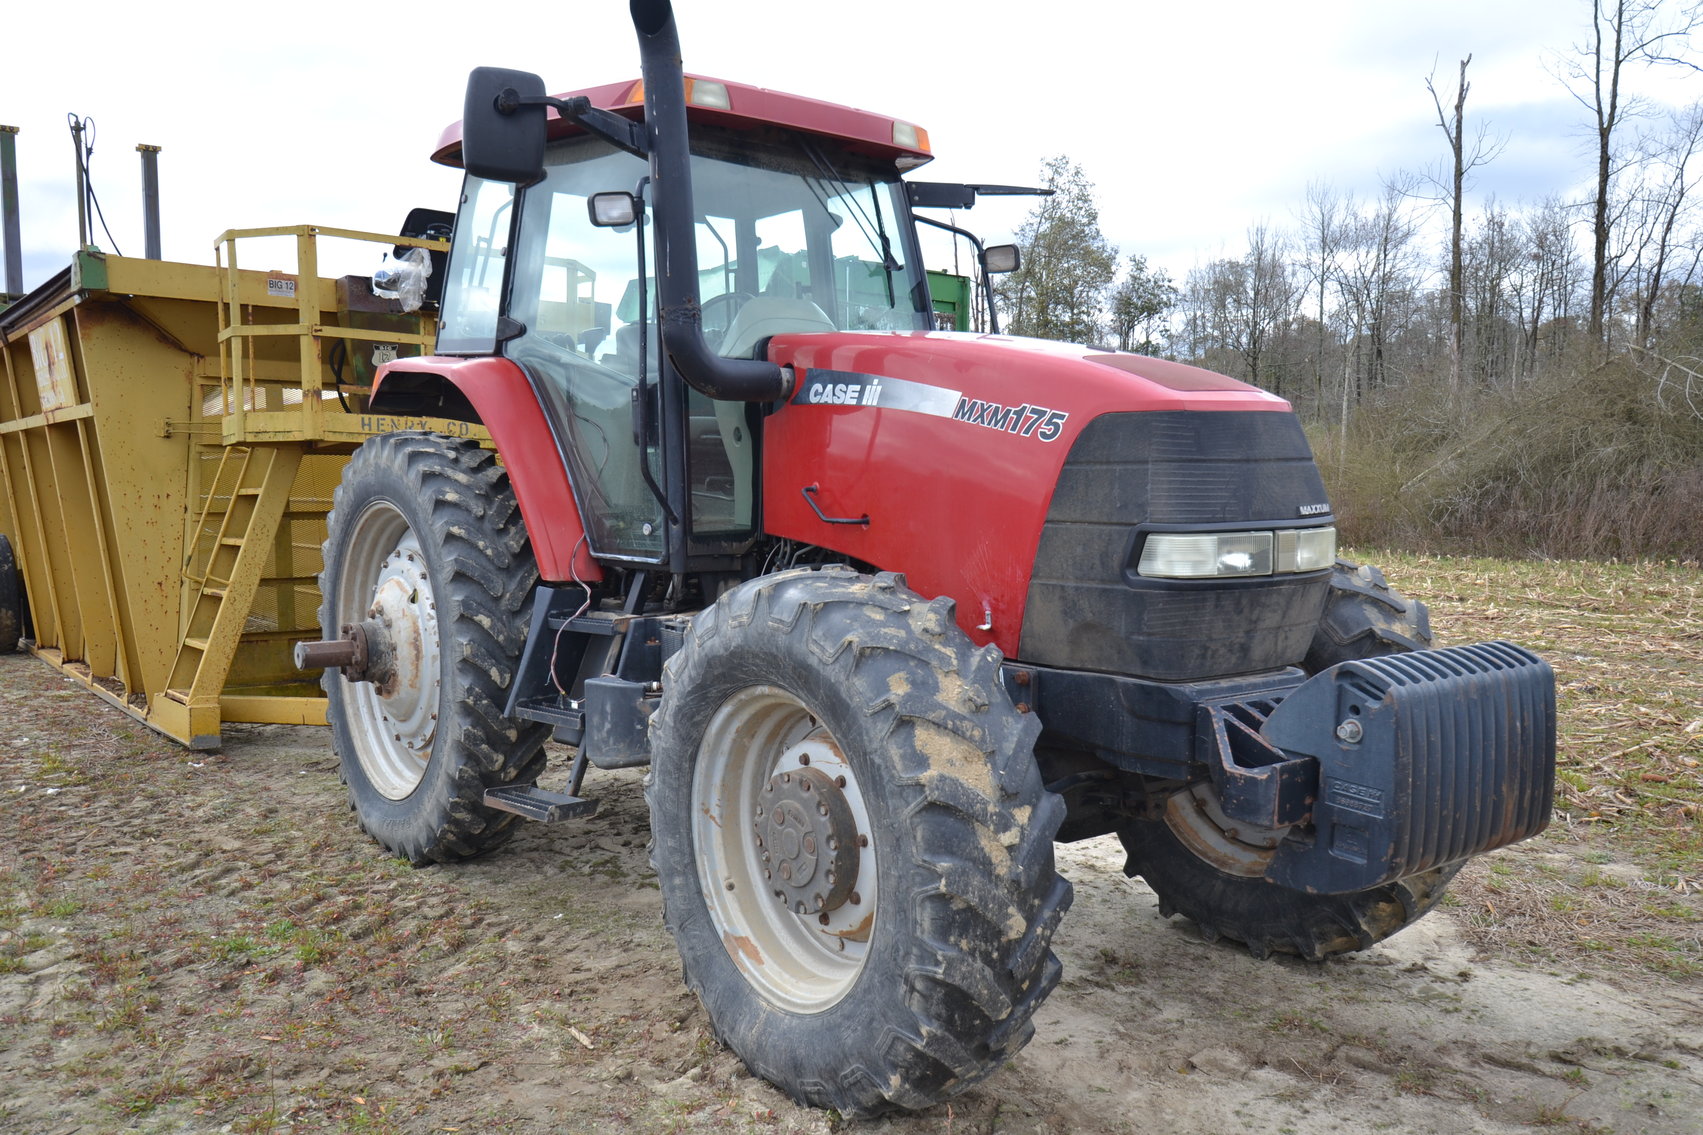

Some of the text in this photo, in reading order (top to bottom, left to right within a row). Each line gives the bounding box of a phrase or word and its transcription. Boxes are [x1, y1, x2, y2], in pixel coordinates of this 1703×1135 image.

[269, 279, 294, 291] BIG 12
[809, 383, 860, 405] CASE
[361, 416, 428, 432] HENRY
[955, 397, 1070, 442] MXM175
[1300, 503, 1330, 515] MAXXUM
[1334, 780, 1367, 797] CASE
